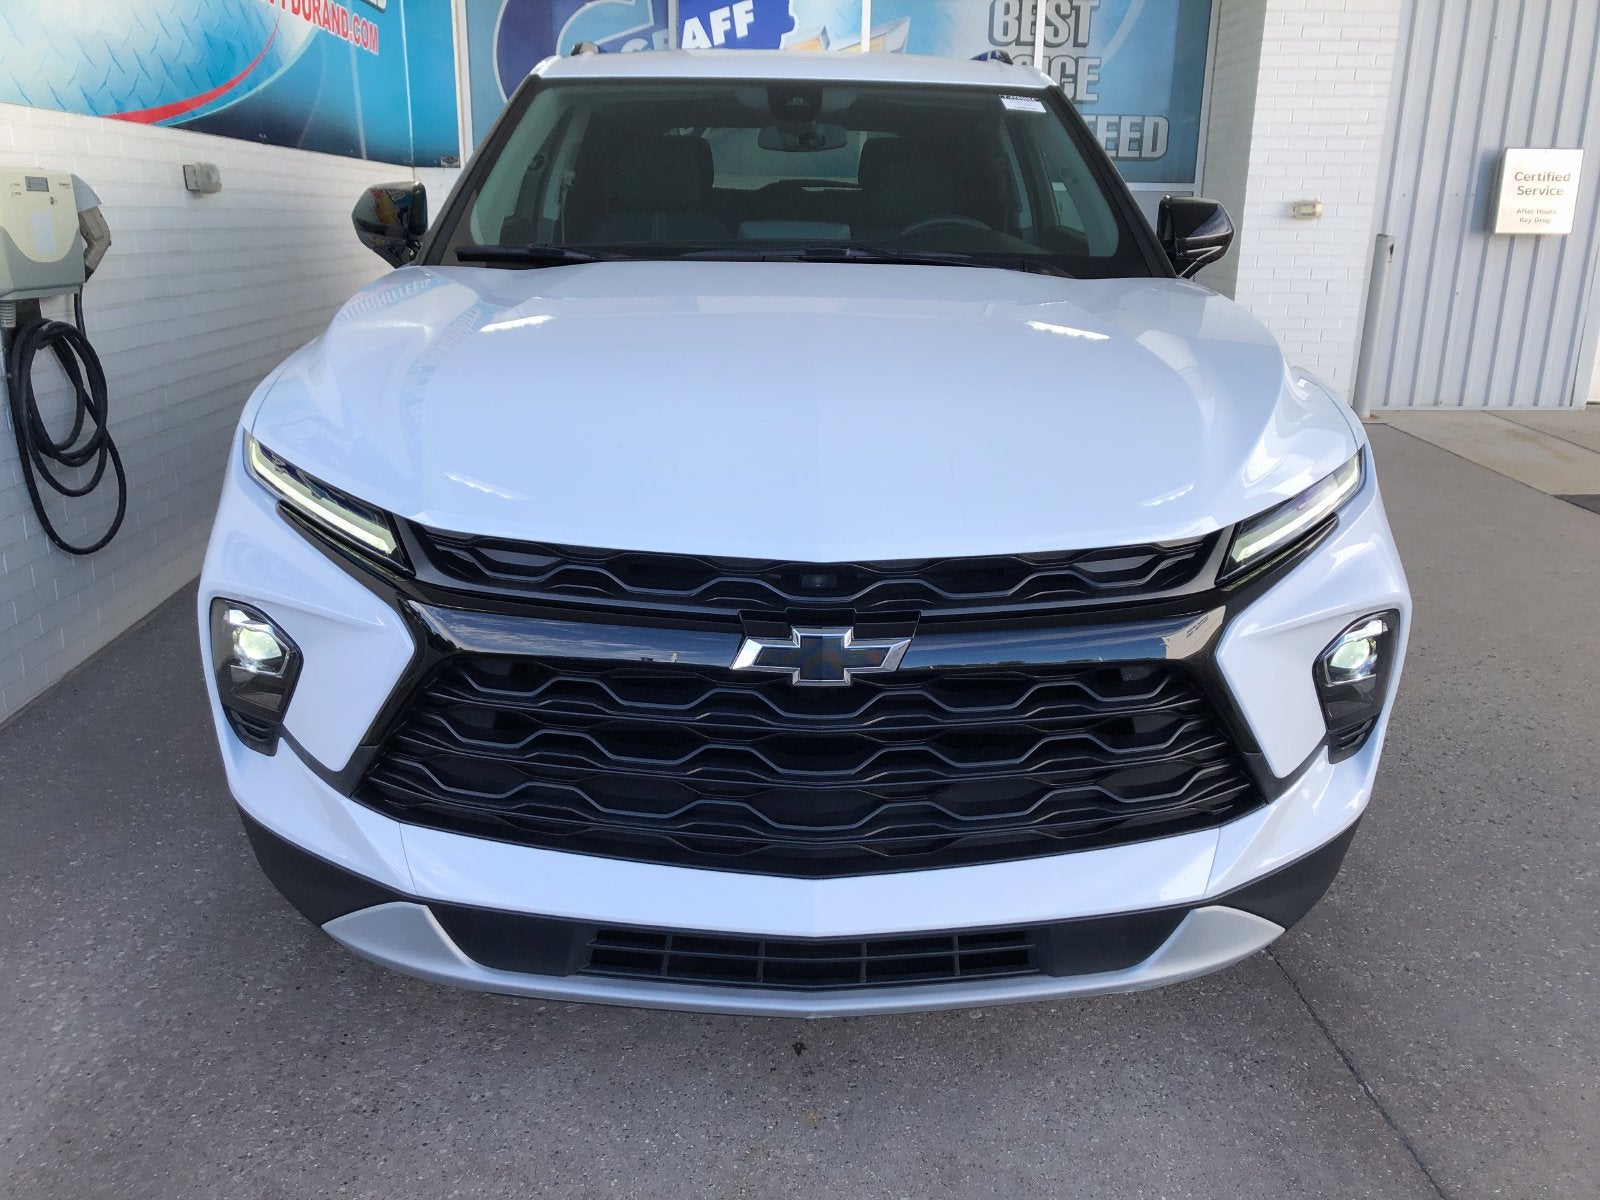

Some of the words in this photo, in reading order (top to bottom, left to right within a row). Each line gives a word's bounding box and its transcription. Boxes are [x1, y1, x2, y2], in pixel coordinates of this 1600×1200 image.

[989, 0, 1100, 47] BEST
[1081, 113, 1170, 161] EED
[1514, 171, 1571, 182] Certified
[1516, 185, 1564, 196] Service
